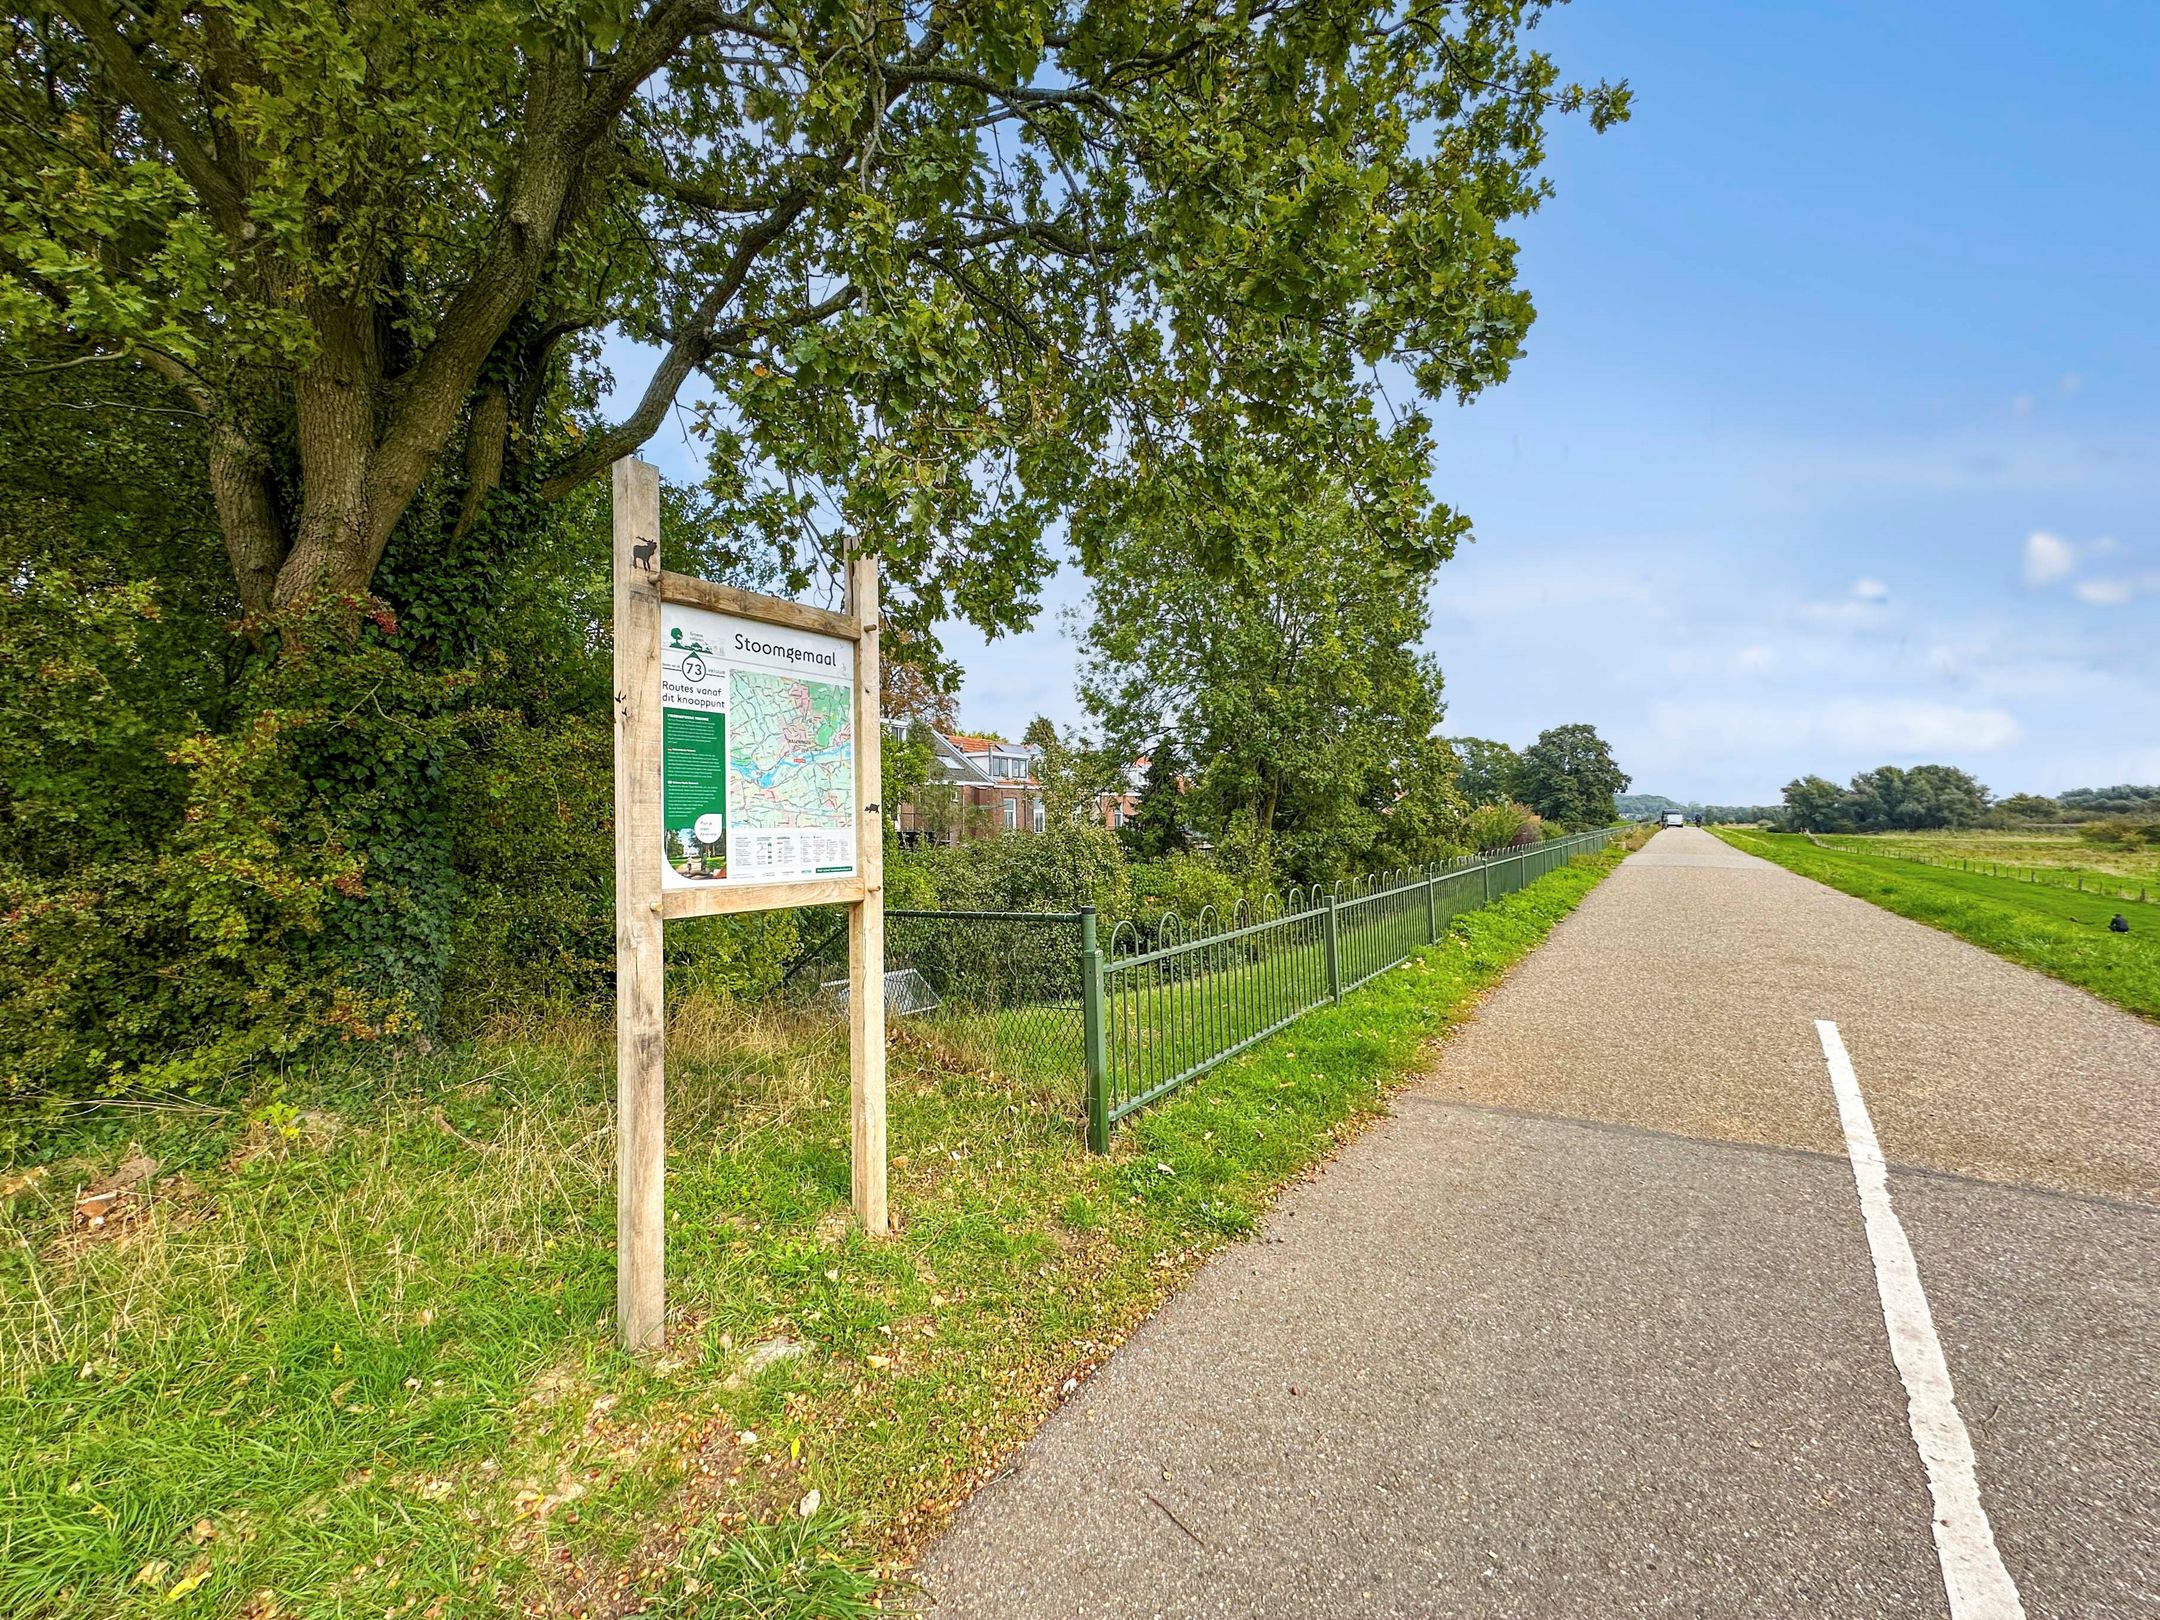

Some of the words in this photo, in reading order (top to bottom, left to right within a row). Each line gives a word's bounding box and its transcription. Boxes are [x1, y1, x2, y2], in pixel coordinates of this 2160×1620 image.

[734, 633, 836, 667] Stoomgemaal
[686, 662, 702, 676] 73
[662, 680, 694, 694] Routes
[696, 686, 722, 697] vanaf
[662, 693, 675, 703] dit
[677, 694, 725, 709] knooppunt
